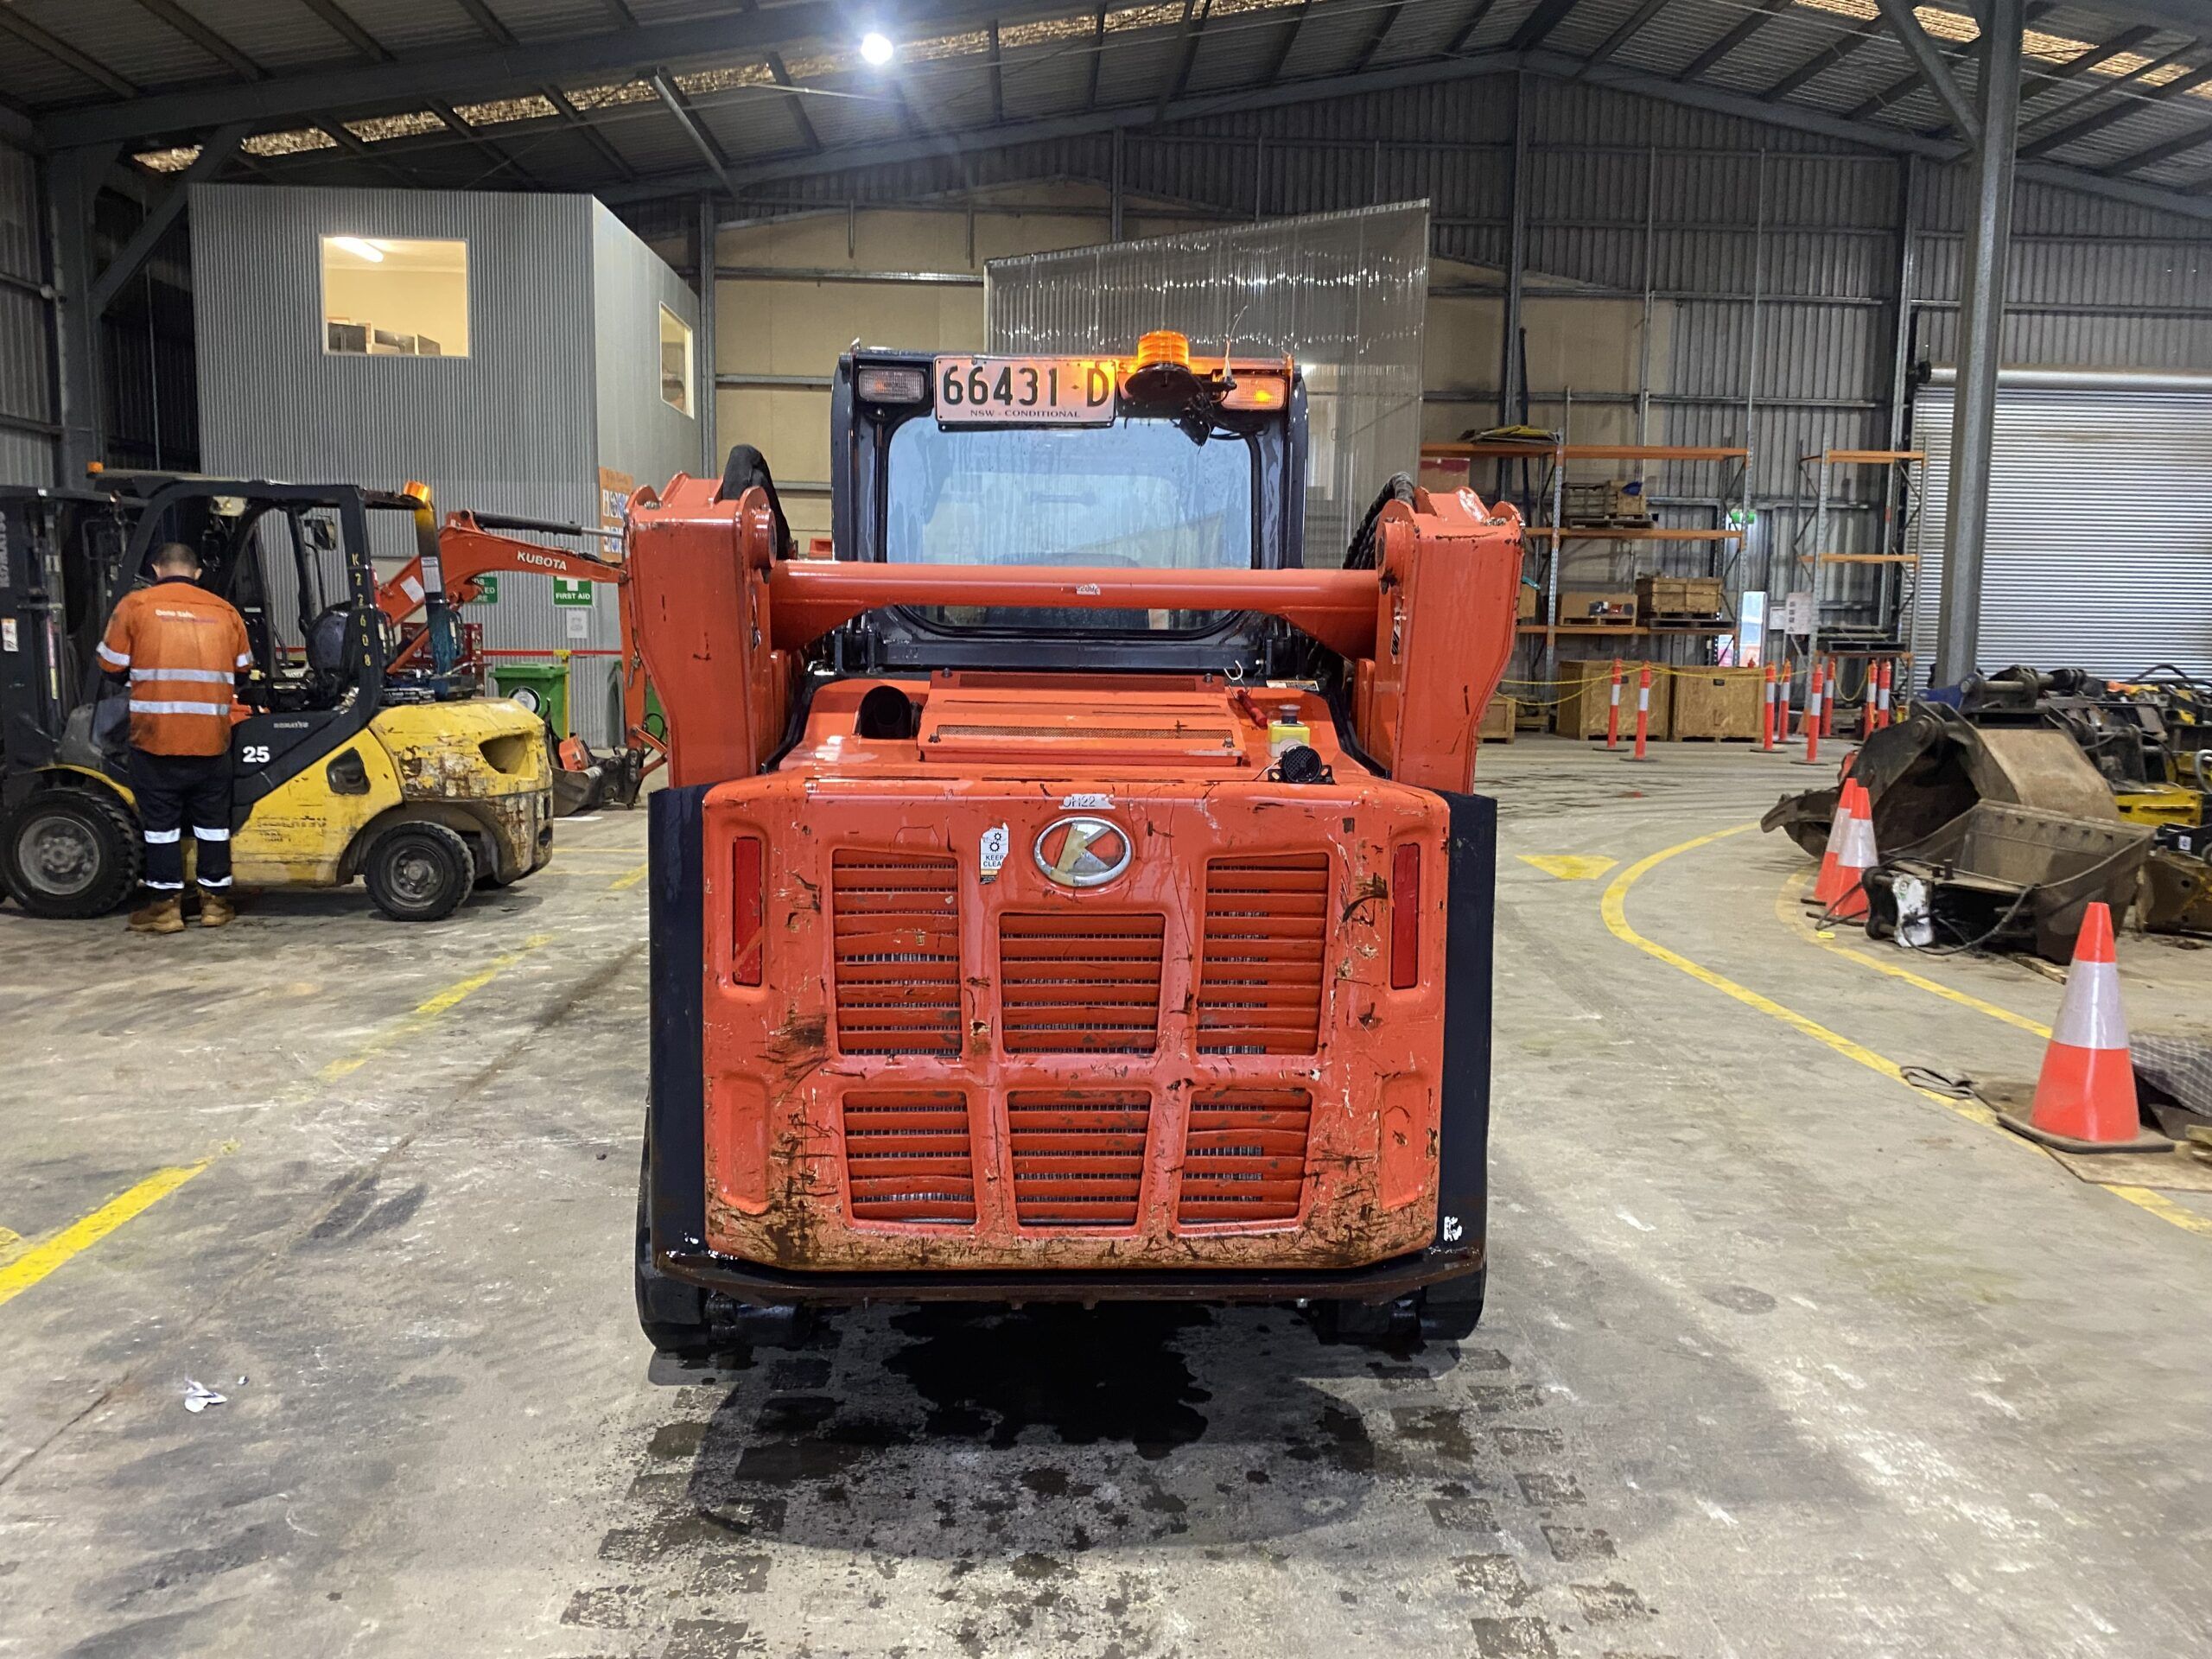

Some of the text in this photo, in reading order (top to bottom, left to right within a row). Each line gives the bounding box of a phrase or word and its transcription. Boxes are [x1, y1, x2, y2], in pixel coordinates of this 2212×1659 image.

[943, 365, 1109, 407] 66431 D
[1005, 410, 1080, 418] CONDITIONAL
[517, 550, 567, 571] KUBOTA
[242, 746, 270, 763] 25
